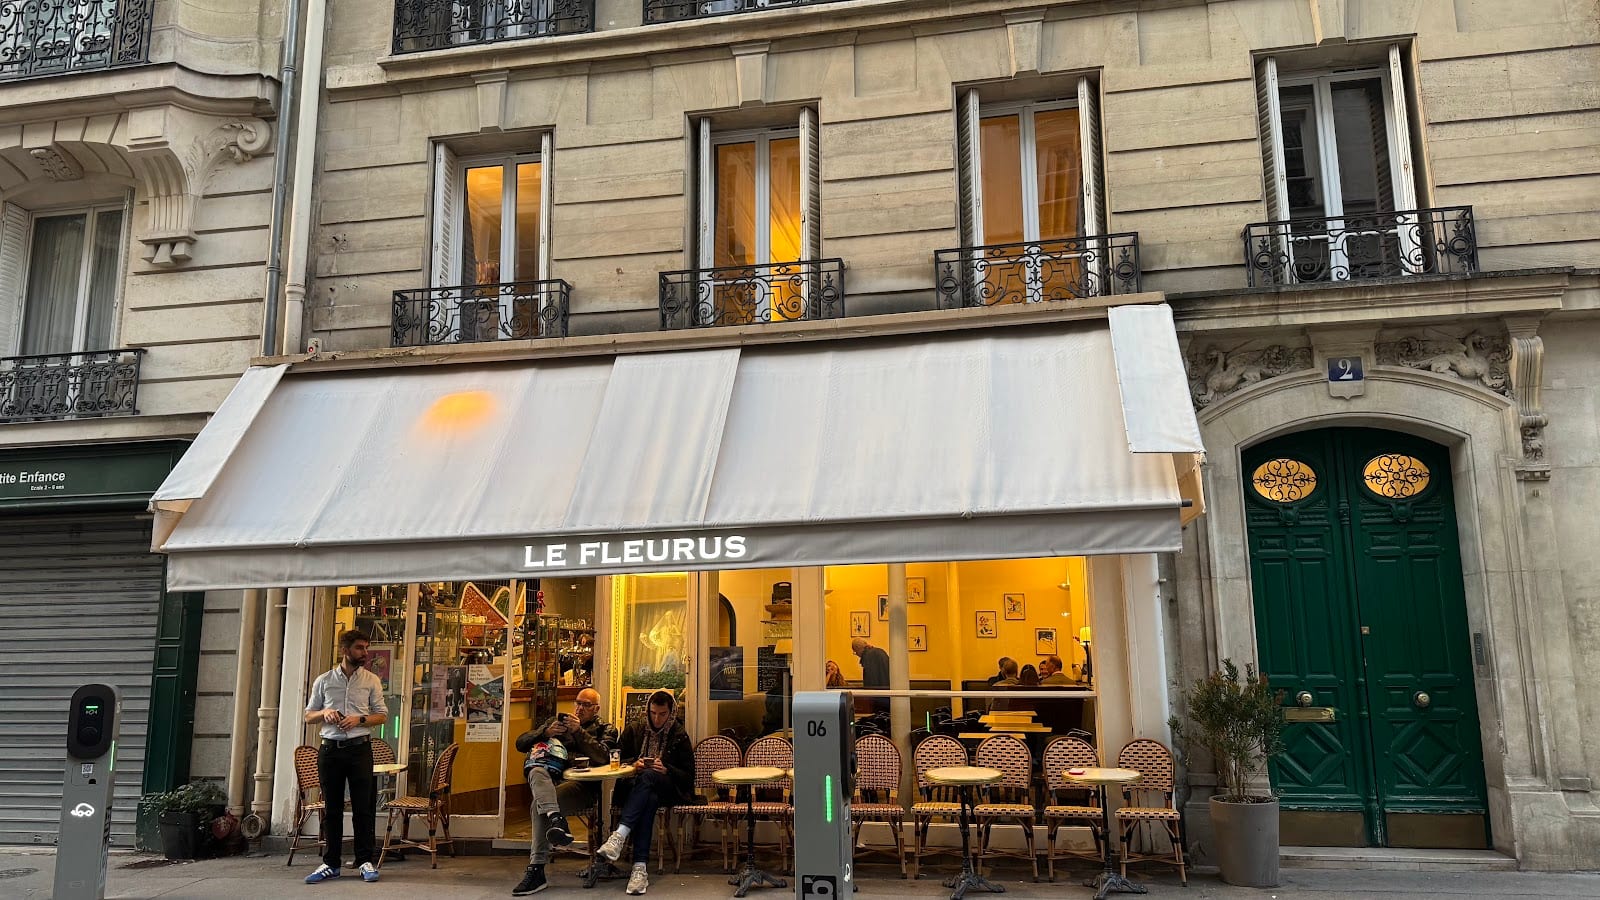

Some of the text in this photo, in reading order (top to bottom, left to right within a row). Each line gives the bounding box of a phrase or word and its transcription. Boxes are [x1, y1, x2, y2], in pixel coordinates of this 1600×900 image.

[1338, 359, 1353, 379] 2
[20, 471, 65, 482] Enfance
[524, 535, 746, 568] LE FLEURUS
[807, 720, 827, 737] 06
